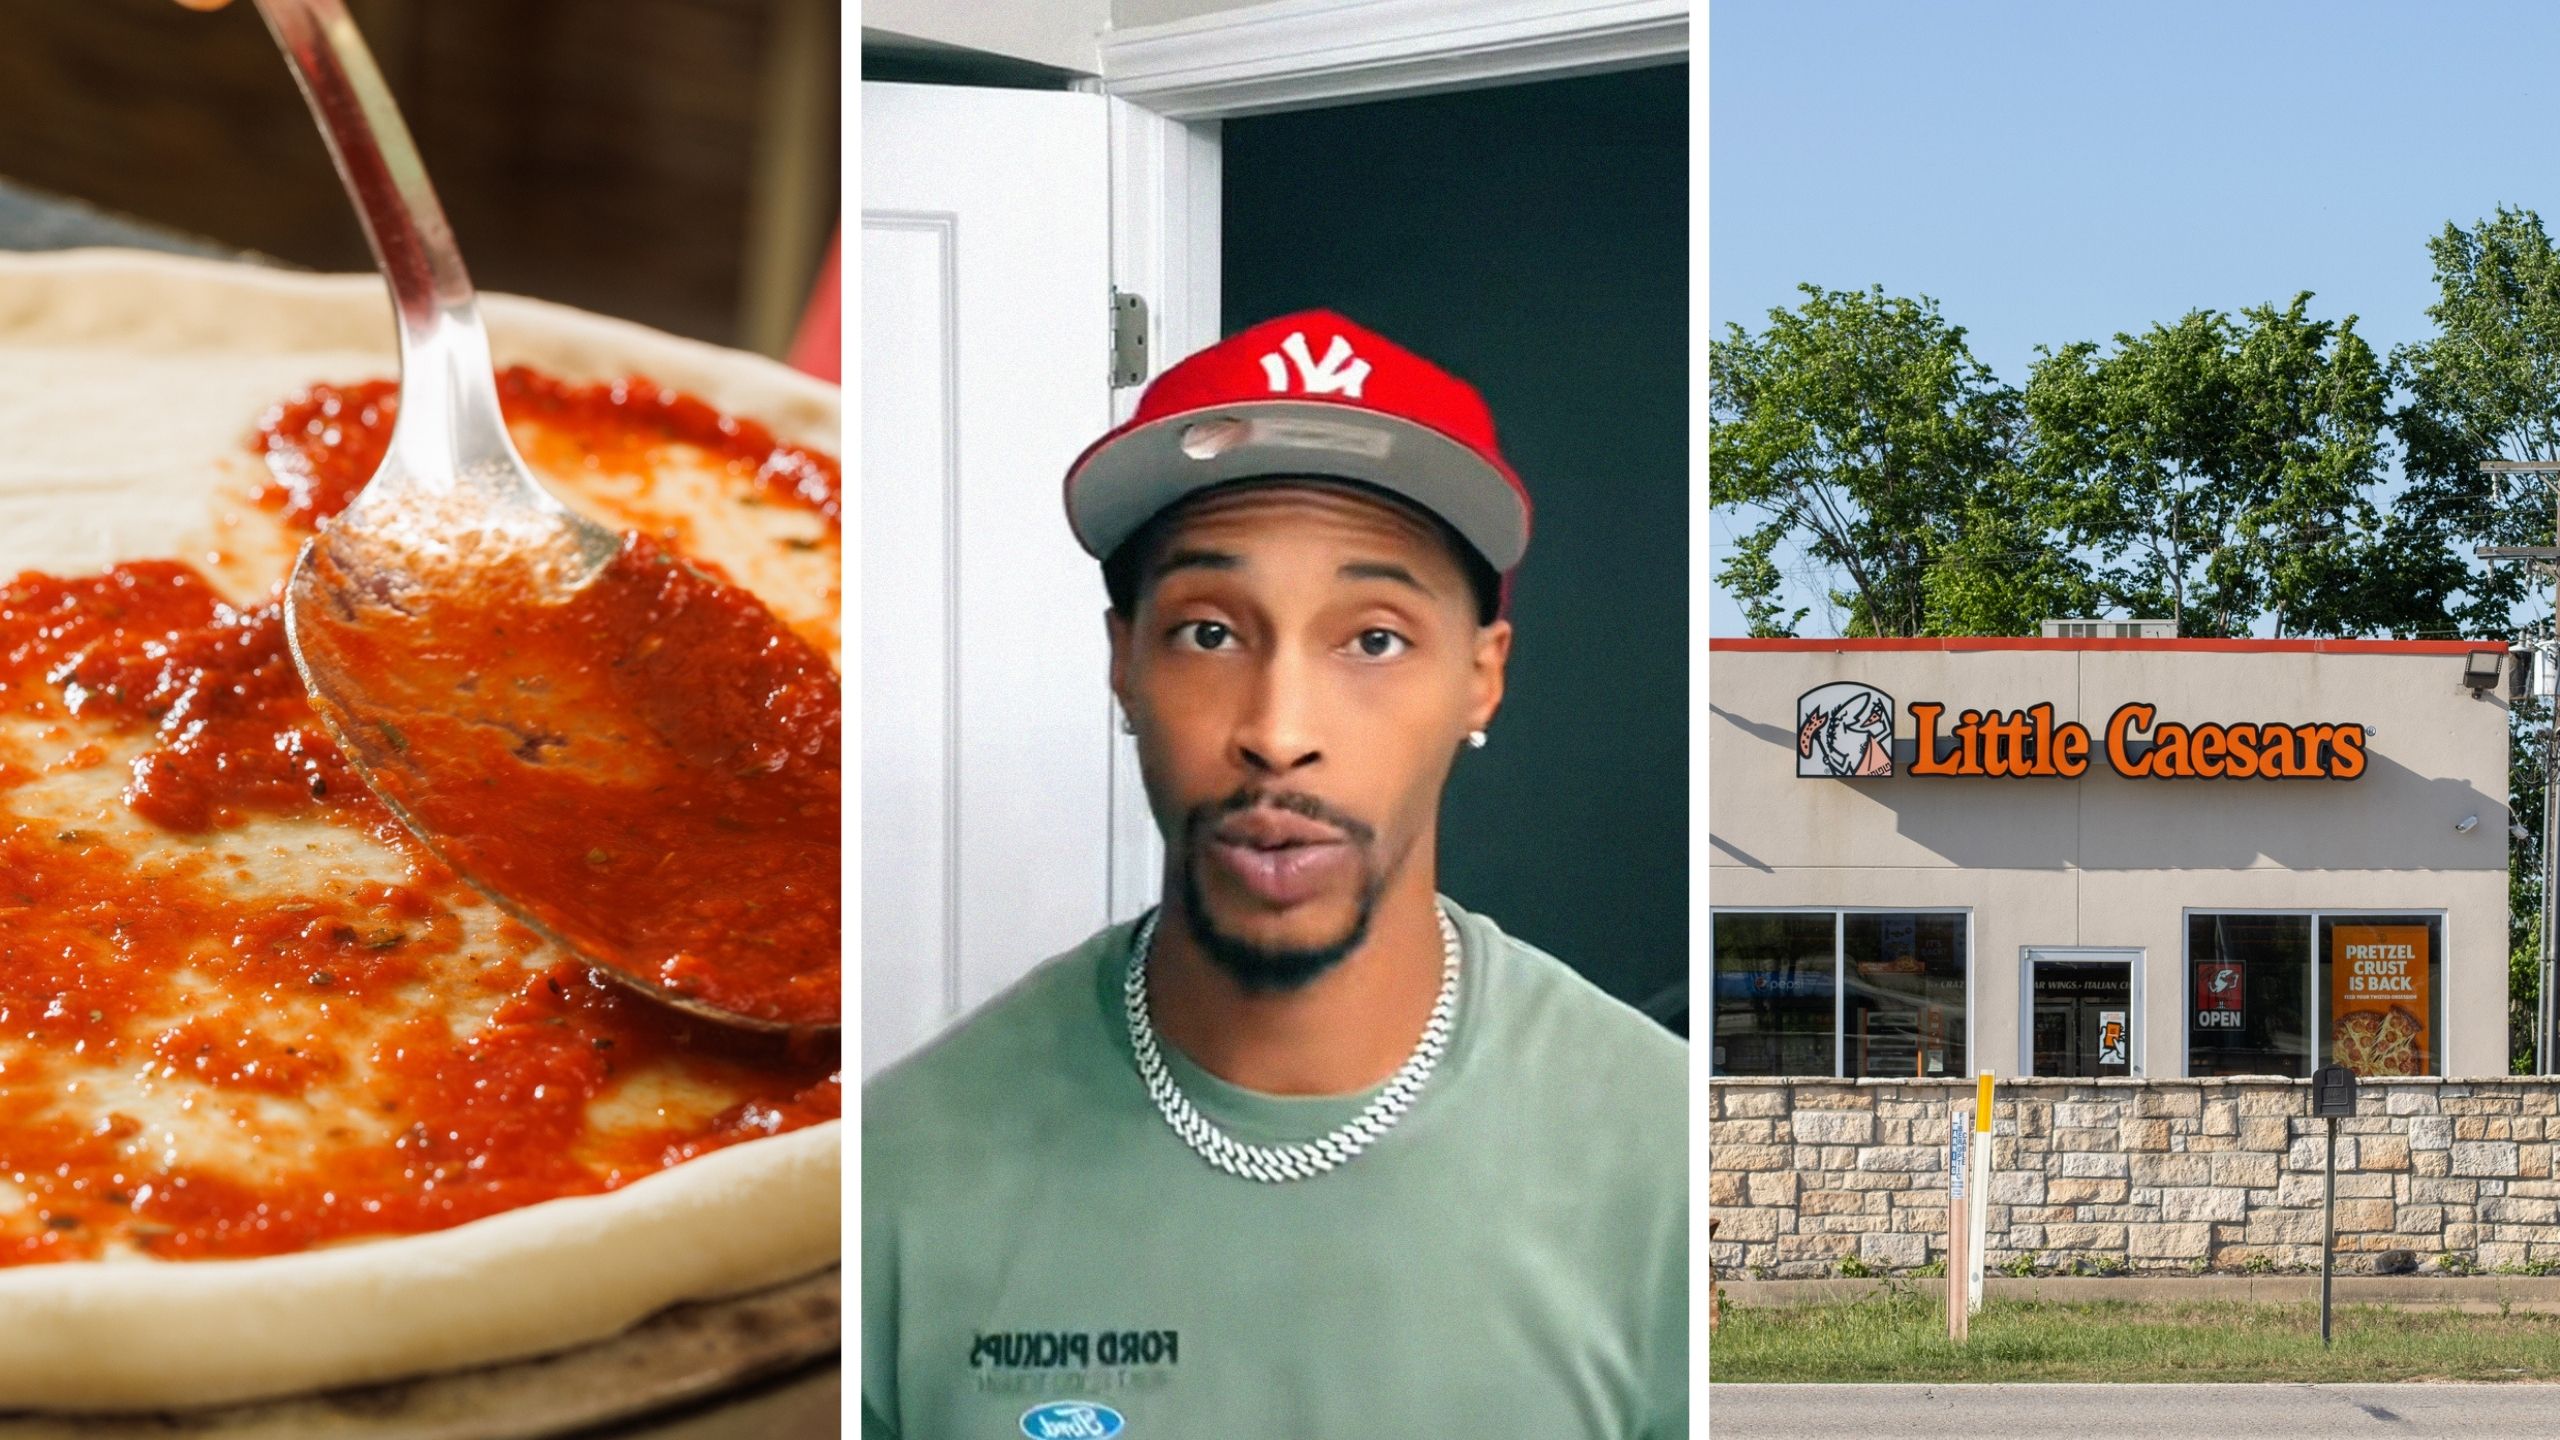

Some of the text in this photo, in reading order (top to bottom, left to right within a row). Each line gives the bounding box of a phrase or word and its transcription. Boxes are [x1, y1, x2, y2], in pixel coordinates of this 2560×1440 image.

[1907, 702, 2369, 780] Little Caesars
[2345, 944, 2416, 960] PRETZEL
[2353, 960, 2408, 976] CRUST
[2349, 976, 2413, 991] IS BACK
[2199, 1011, 2241, 1028] OPEN
